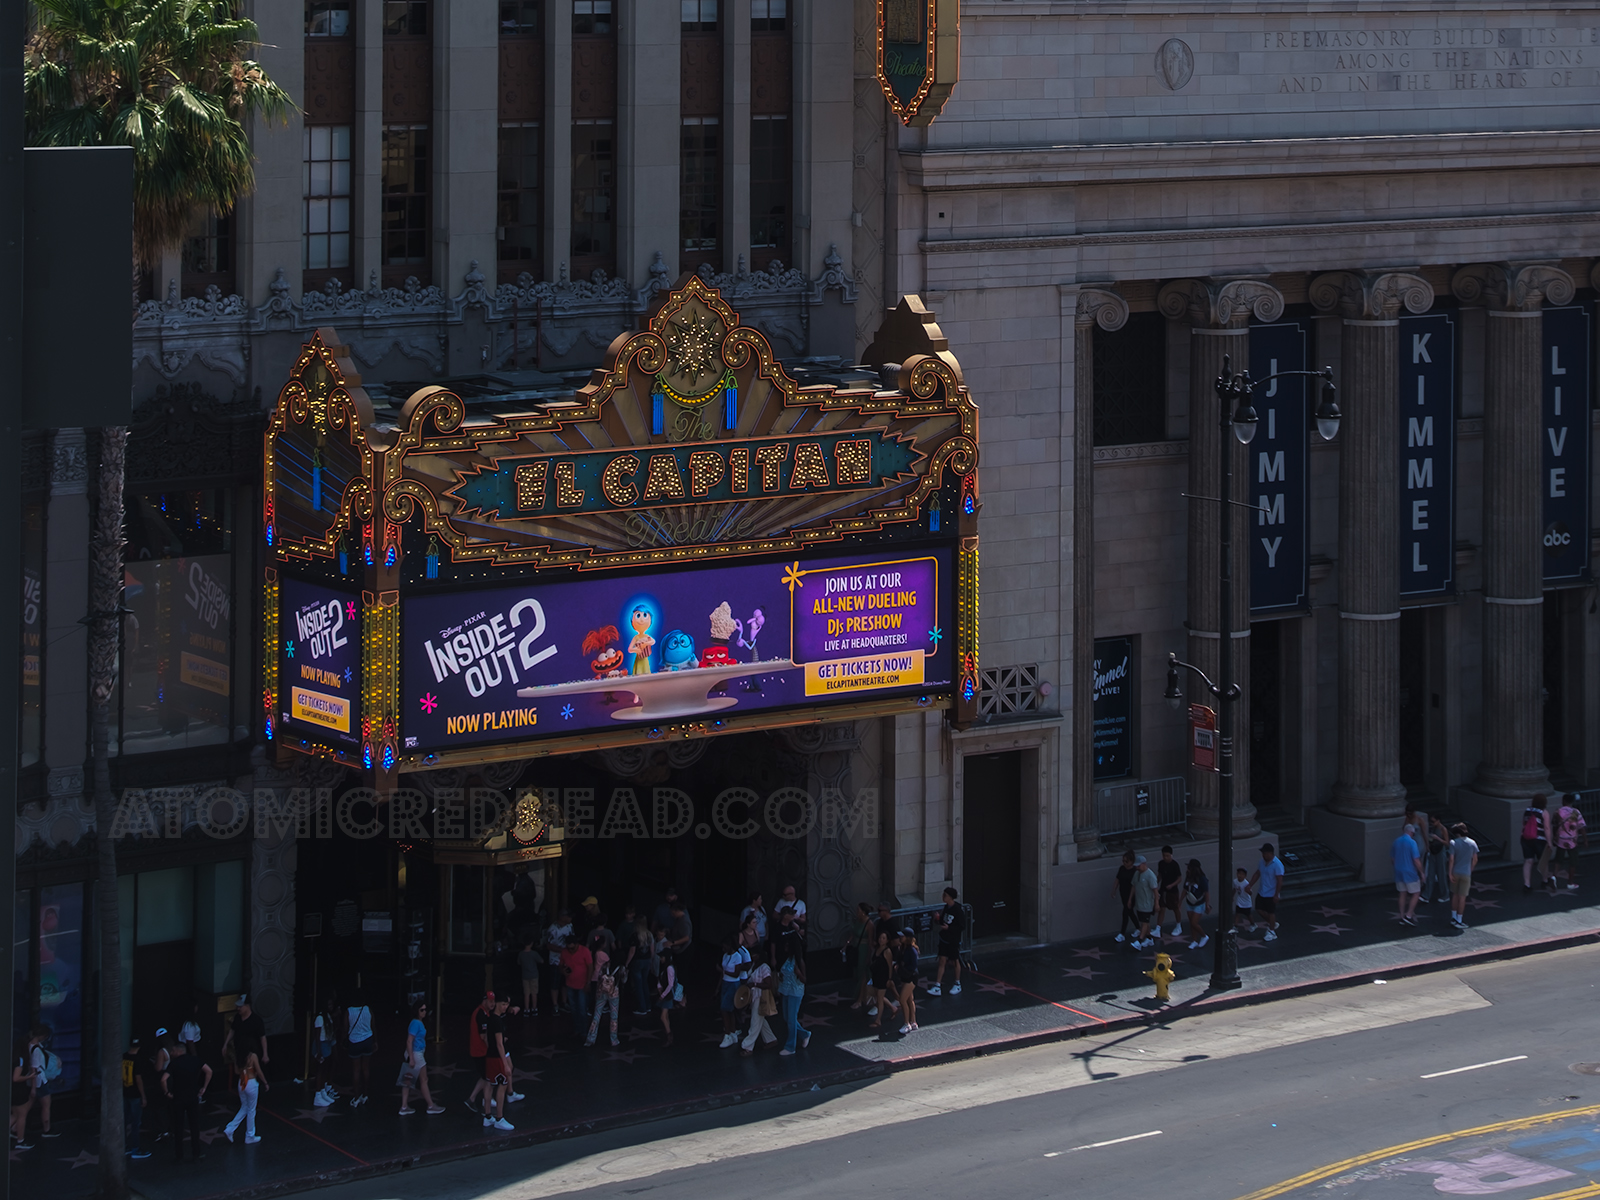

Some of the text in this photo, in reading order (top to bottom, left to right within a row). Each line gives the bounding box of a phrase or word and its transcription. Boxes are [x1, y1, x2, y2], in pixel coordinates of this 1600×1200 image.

[1263, 30, 1412, 49] FREEMASONRY
[1433, 28, 1507, 47] BUILDS
[1527, 27, 1558, 45] ITS
[884, 50, 926, 77] Theatre
[1336, 49, 1584, 70] AMONG THE NATIONS
[1279, 71, 1573, 94] AND IN THE HEARTS OF
[672, 408, 715, 442] The
[1548, 345, 1568, 498] LIVE
[1257, 358, 1286, 569] JIMMY
[1407, 332, 1434, 573] KIMMEL
[514, 439, 873, 512] EL CAPITAN
[624, 511, 758, 548] Theatre
[1543, 529, 1571, 547] abc
[825, 572, 901, 596] JOIN US AT OUR
[813, 591, 917, 614] ALL-NEW DUELING
[295, 604, 331, 642] INSIDE
[310, 627, 332, 659] OUT
[328, 599, 348, 650] 2
[439, 611, 486, 639] Disney PIXAR
[827, 613, 902, 637] DJs PRESHOW
[424, 613, 516, 684] INSIDE
[465, 597, 558, 698] OUT 2
[824, 633, 908, 652] LIVE AT HEADQUARTERS!
[300, 664, 341, 688] NOW PLAYING
[818, 656, 912, 678] GET TICKETS NOW!
[826, 675, 900, 689] ELCAPITANTHEATRE.COM
[1101, 686, 1120, 696] LIVE!
[309, 696, 328, 712] TICKETS
[447, 707, 537, 735] NOW PLAYING
